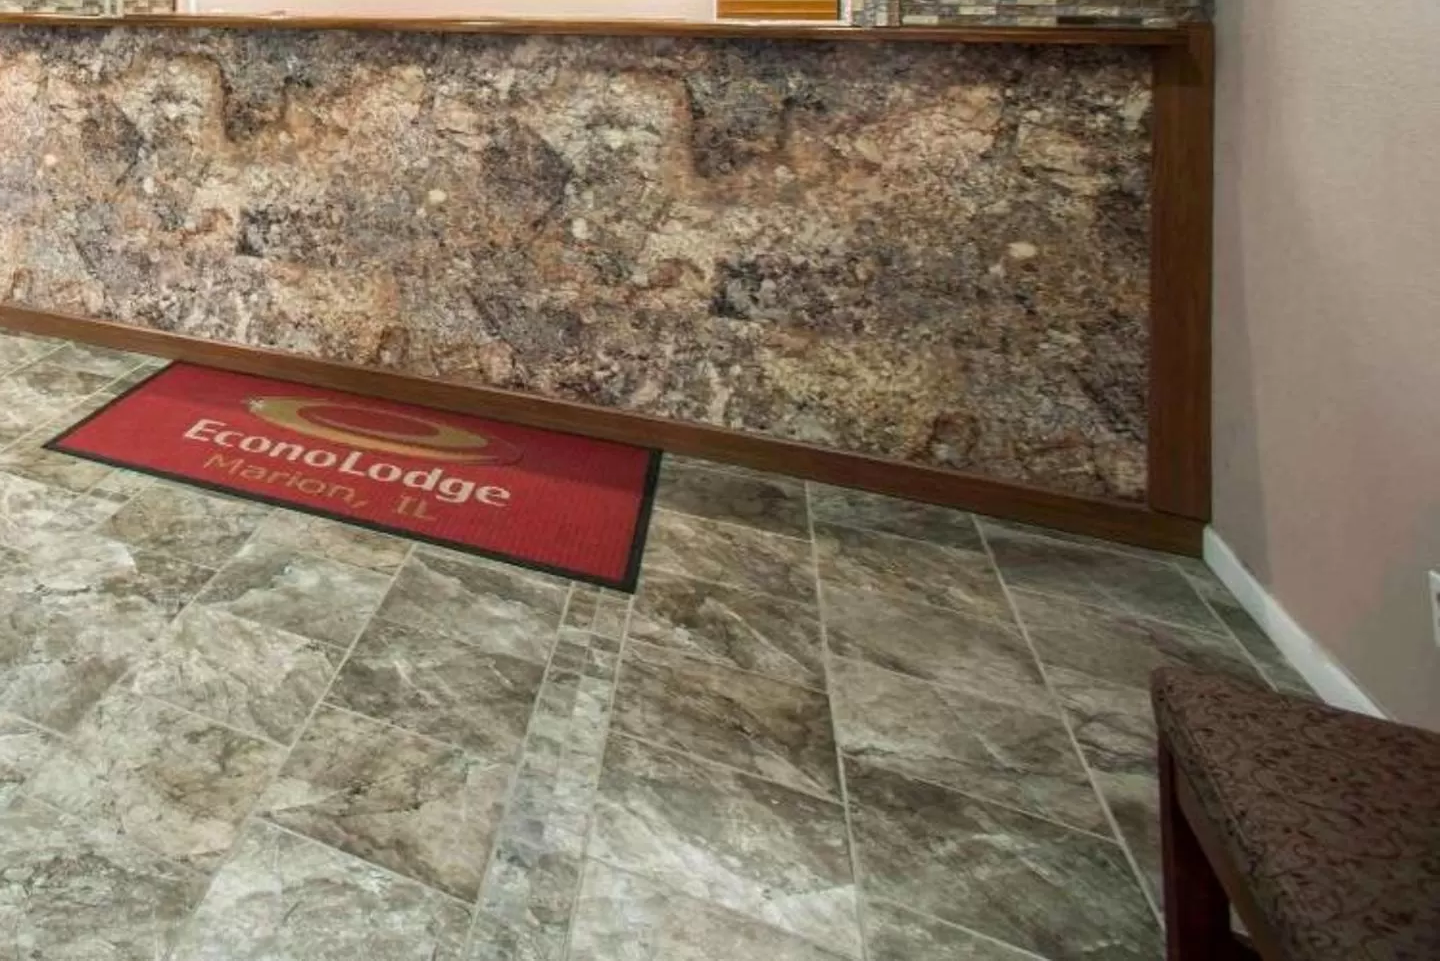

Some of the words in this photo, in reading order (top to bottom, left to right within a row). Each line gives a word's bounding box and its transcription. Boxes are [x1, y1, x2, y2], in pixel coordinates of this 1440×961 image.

[183, 417, 512, 507] EconoLodge
[203, 453, 367, 509] Marion,
[395, 493, 438, 522] IL
